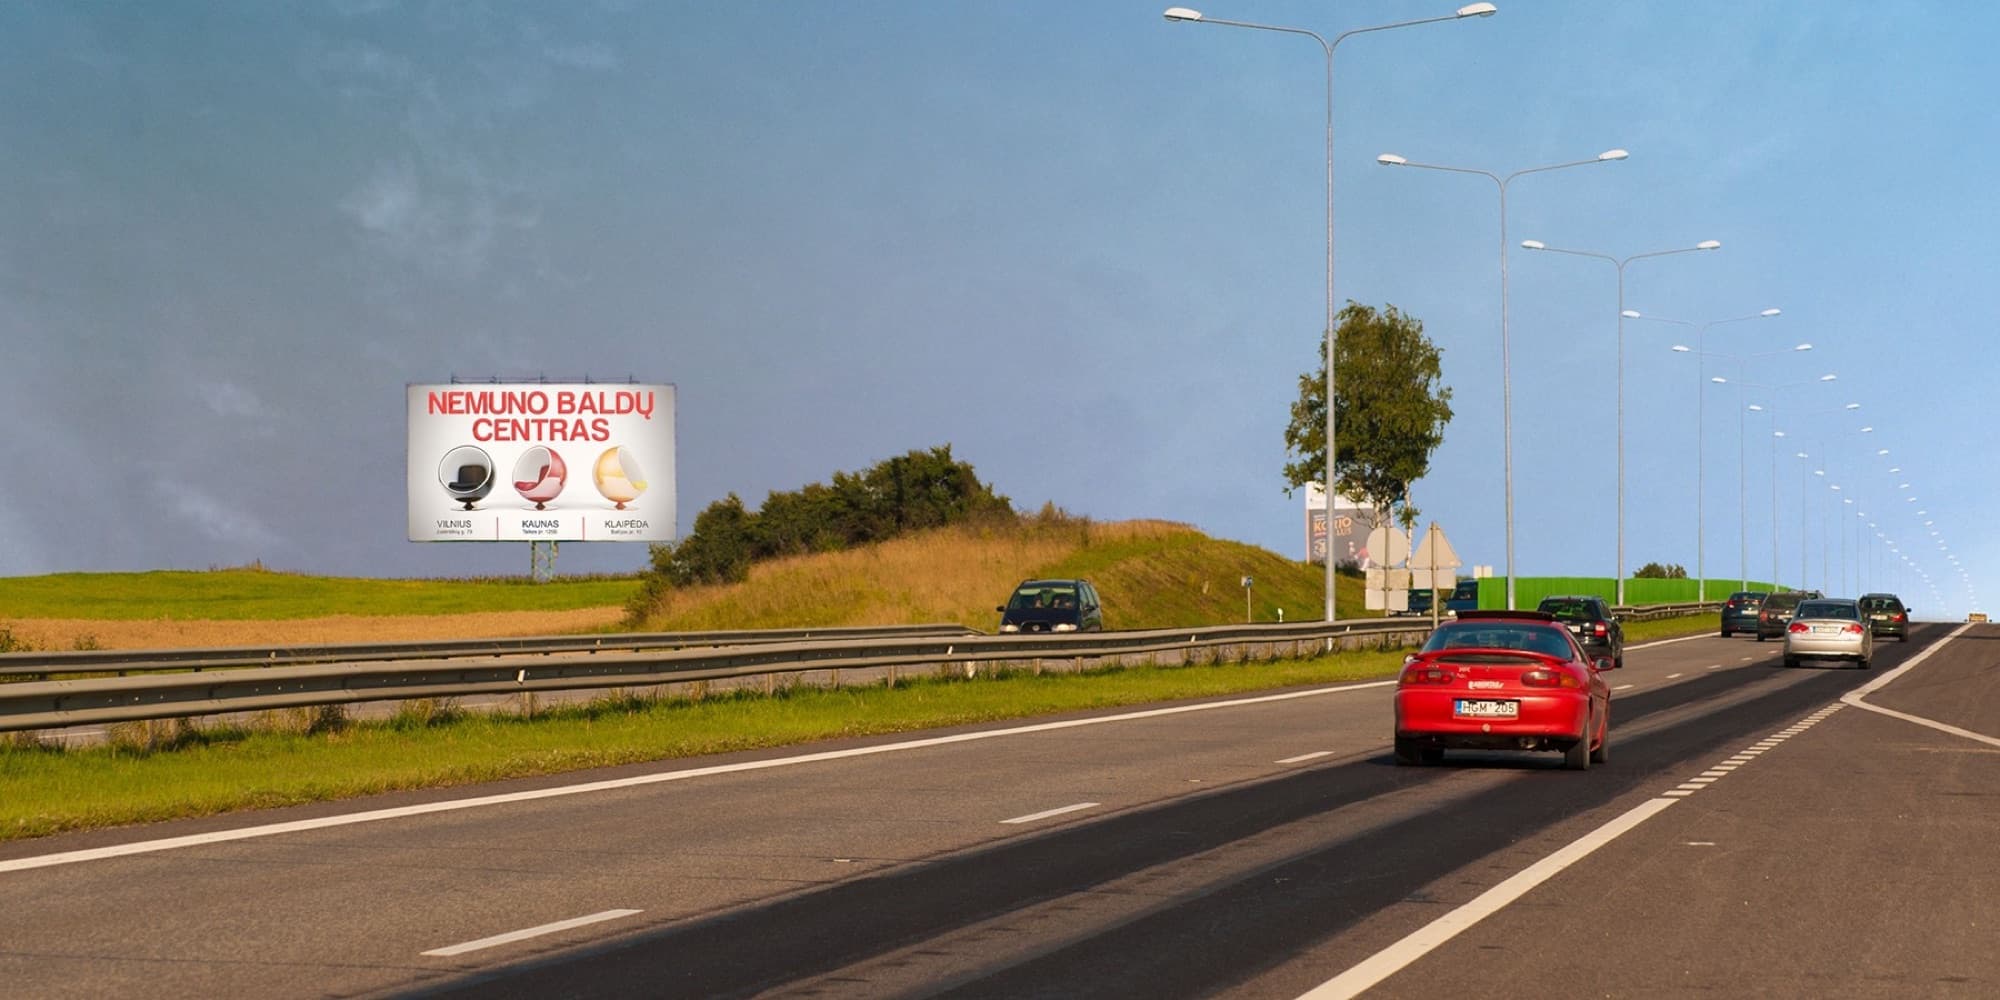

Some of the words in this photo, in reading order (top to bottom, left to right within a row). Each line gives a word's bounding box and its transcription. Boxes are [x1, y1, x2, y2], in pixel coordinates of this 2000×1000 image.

[428, 391, 549, 415] NEMUNO
[557, 391, 655, 419] BALDŲ
[472, 418, 610, 442] CENTRAS
[436, 519, 472, 528] VILNIUS
[521, 519, 560, 528] KAUNAS
[1462, 703, 1488, 713] HGM
[1494, 703, 1514, 713] 205
